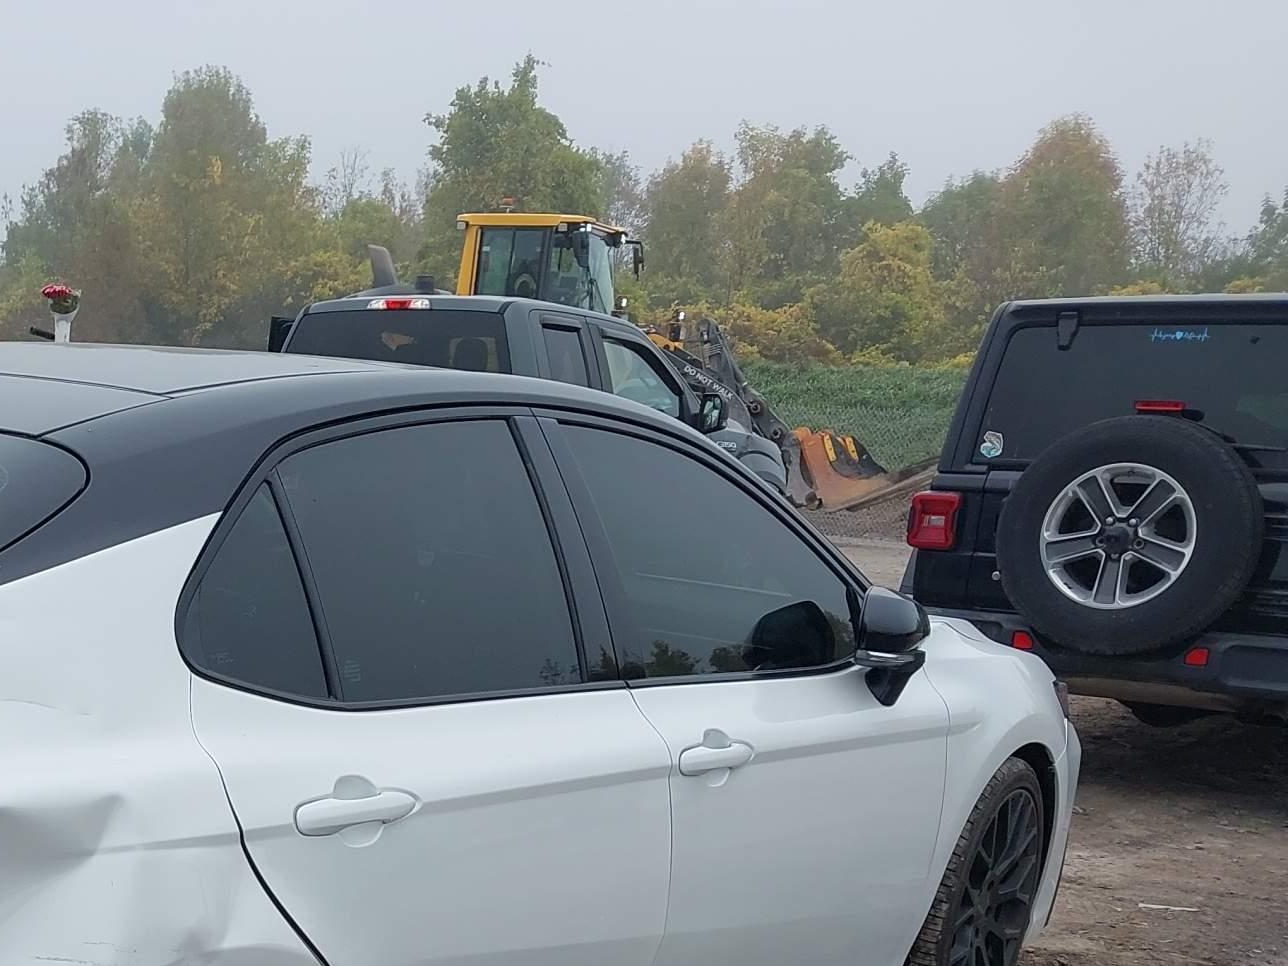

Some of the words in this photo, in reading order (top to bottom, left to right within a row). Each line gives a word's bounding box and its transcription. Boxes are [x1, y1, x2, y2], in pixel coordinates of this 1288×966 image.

[683, 365, 697, 376] DO
[695, 372, 713, 387] NOT
[712, 383, 734, 400] WALK
